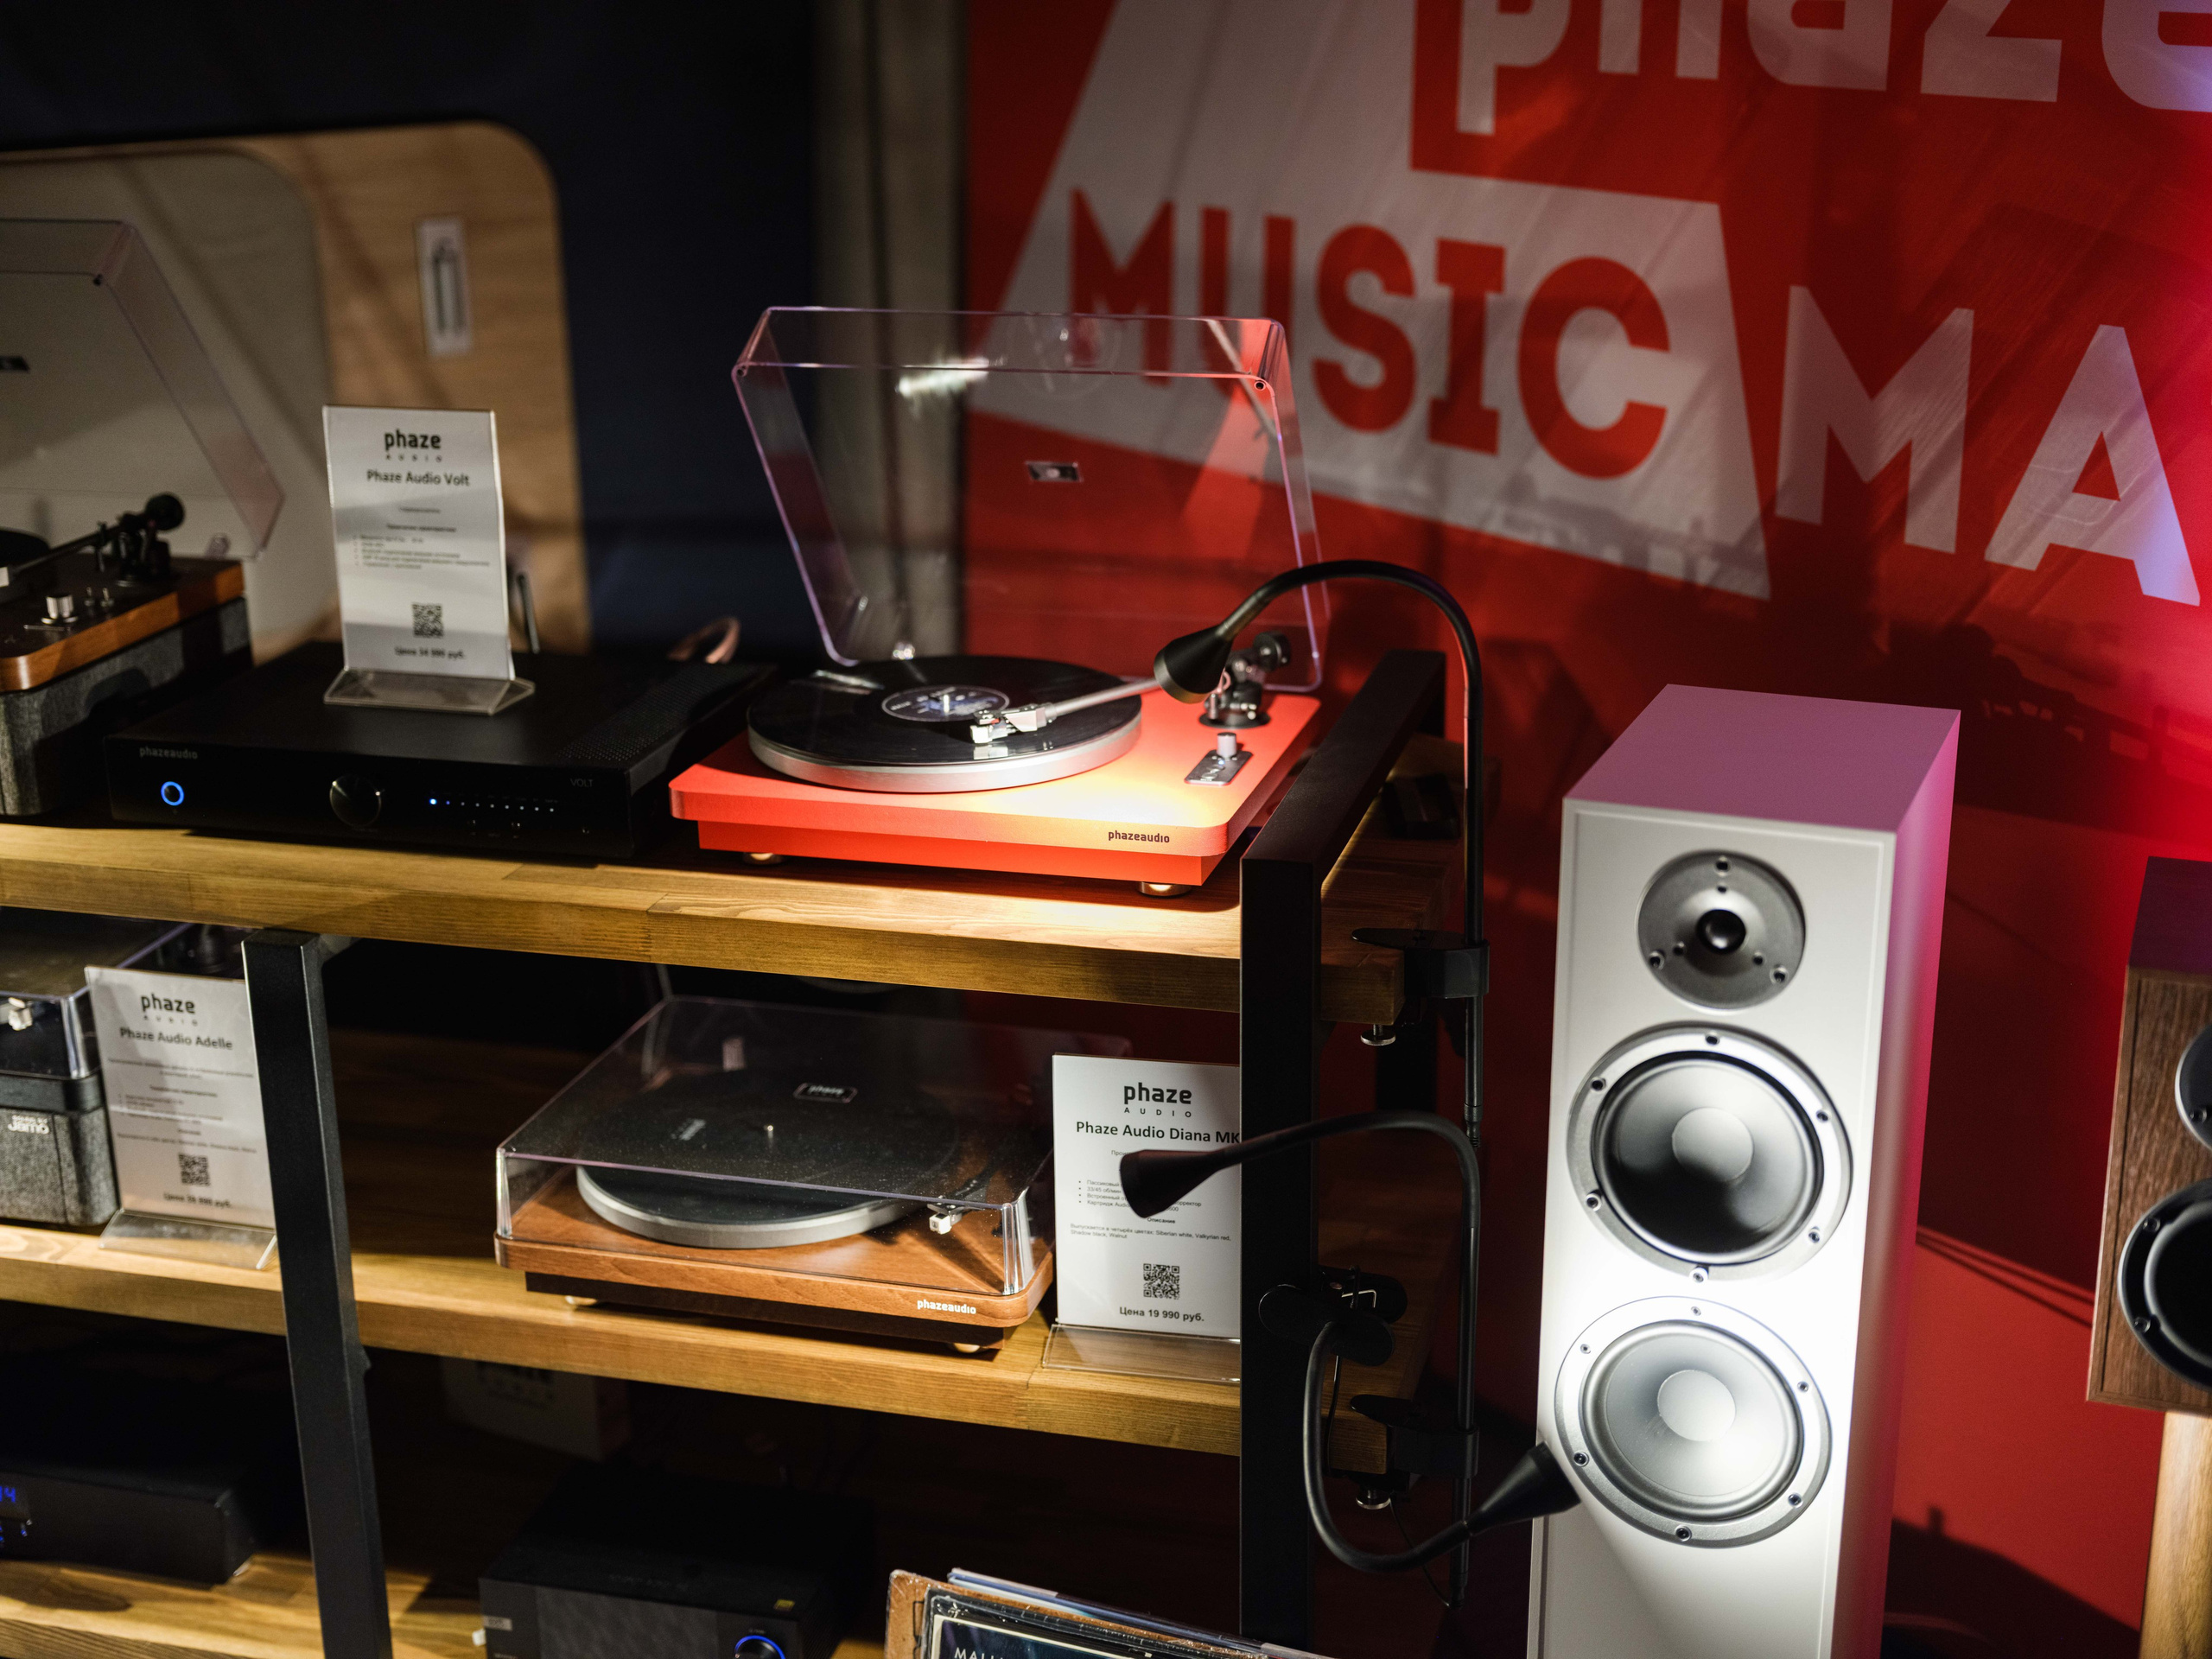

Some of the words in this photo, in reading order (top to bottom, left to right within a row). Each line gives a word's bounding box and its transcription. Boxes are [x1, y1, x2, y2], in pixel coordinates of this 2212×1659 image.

[1068, 187, 1671, 480] MUSIC
[1775, 283, 2201, 607] MA
[385, 429, 442, 452] phaze
[366, 469, 402, 483] Phaze
[406, 471, 442, 485] Audio
[444, 473, 469, 486] Volt
[139, 746, 199, 760] phazeaudio
[570, 778, 594, 788] VOLT
[1108, 830, 1170, 843] phazeaudio
[141, 993, 196, 1014] phaze
[119, 1027, 155, 1042] Phaze
[157, 1031, 192, 1046] Audio
[195, 1036, 232, 1051] Adelle
[1123, 1082, 1192, 1104] phaze
[1124, 1107, 1192, 1117] AUDIO
[1076, 1122, 1118, 1135] Phaze
[1122, 1124, 1165, 1139] Audio
[1170, 1128, 1211, 1141] Diana
[917, 1299, 977, 1315] phazeaudio
[1119, 1306, 1145, 1317] Цена
[1148, 1309, 1160, 1318] 19
[1161, 1310, 1180, 1319] 990
[1182, 1313, 1205, 1323] руб.
